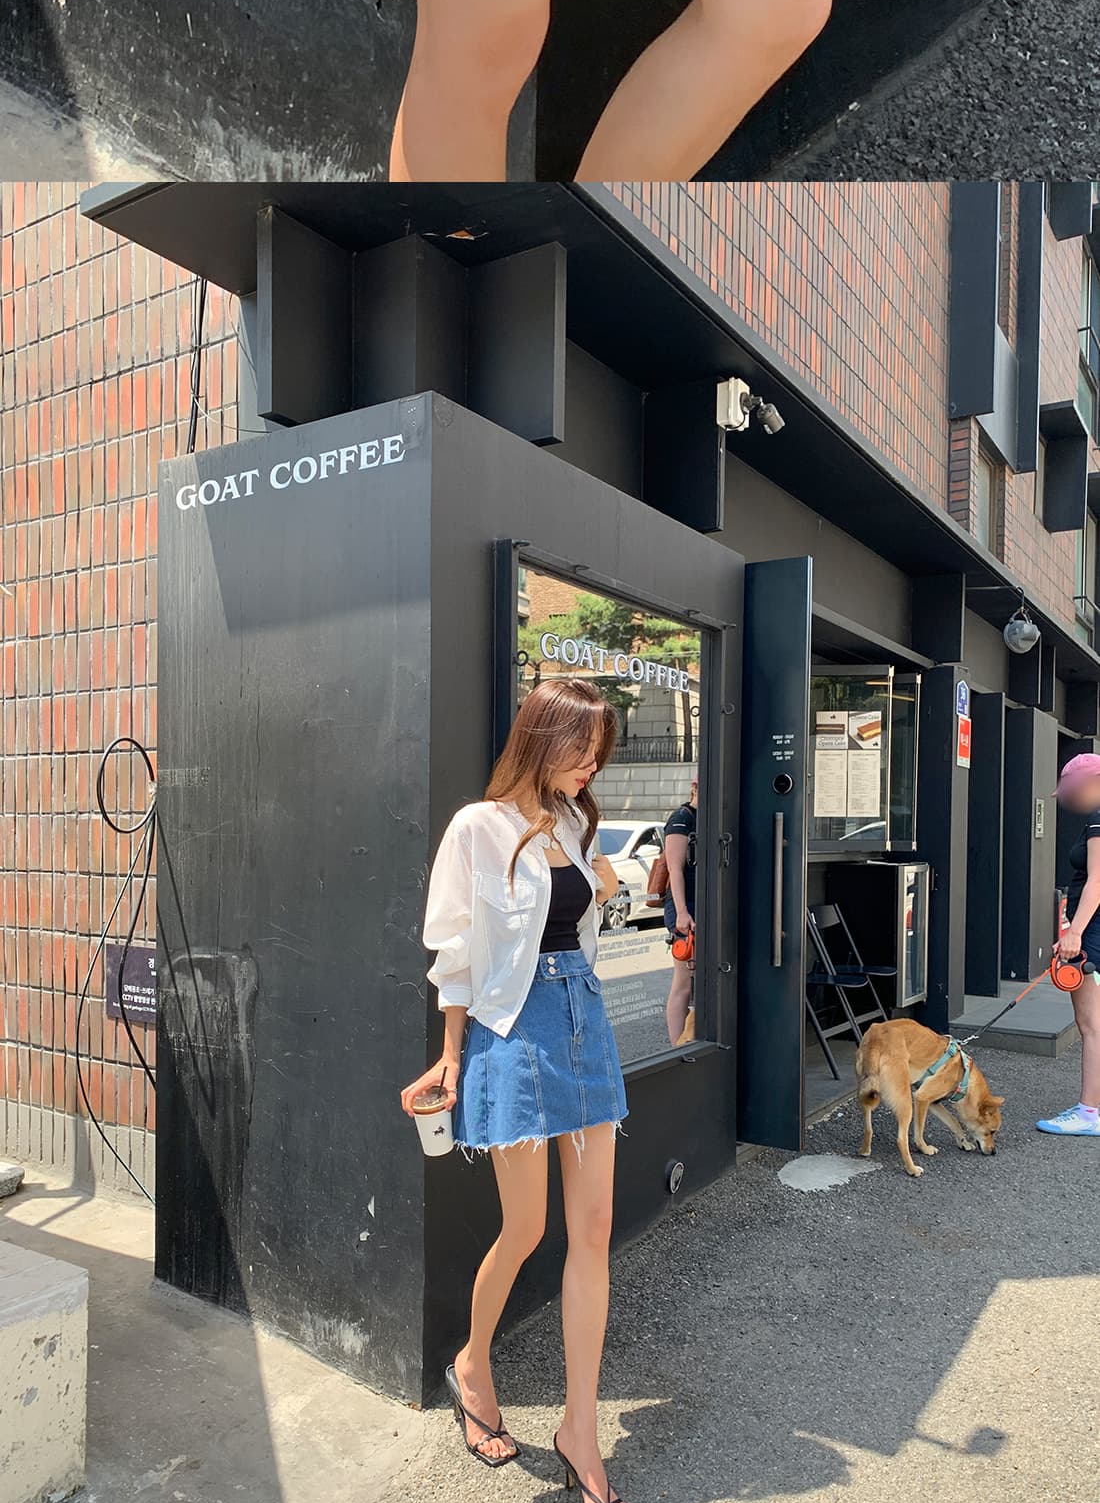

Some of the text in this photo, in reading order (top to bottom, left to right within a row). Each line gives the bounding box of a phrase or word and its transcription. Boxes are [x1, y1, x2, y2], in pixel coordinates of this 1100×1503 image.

[176, 434, 406, 511] GOAT COFFEE
[540, 632, 690, 693] GOAT COFFEE
